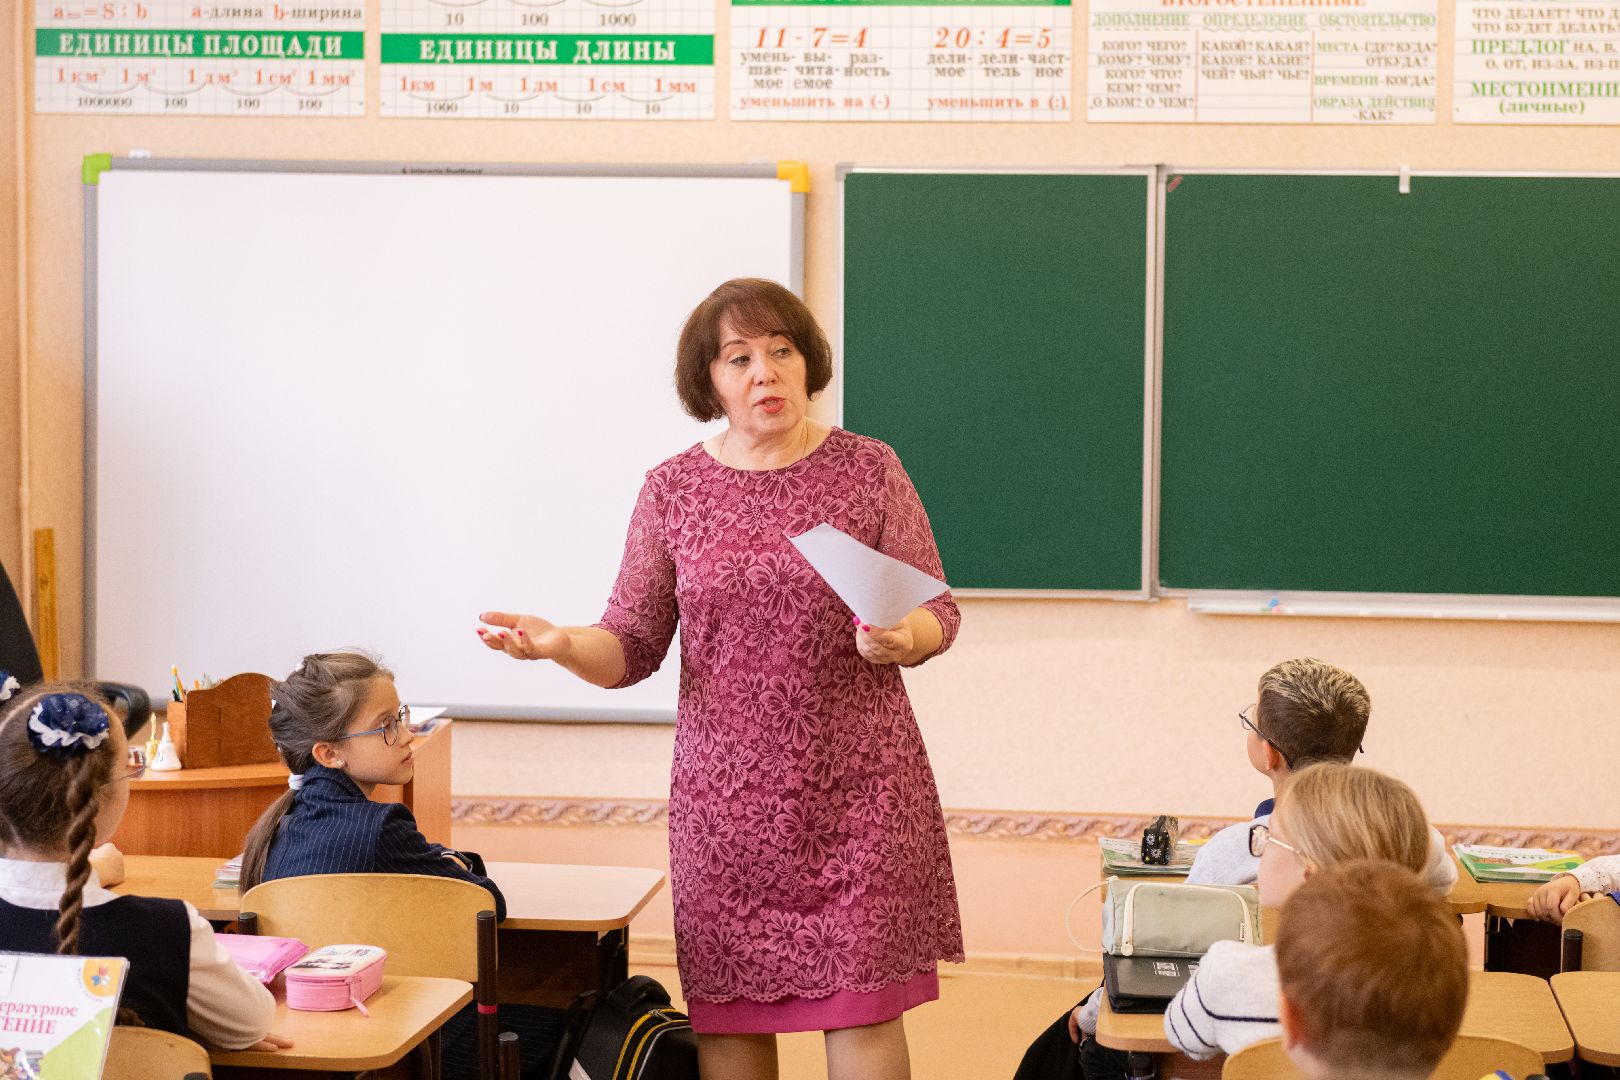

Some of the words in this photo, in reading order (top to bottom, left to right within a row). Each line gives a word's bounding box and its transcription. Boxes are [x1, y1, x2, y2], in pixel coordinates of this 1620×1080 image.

[446, 13, 464, 26] 10
[521, 13, 549, 26] 100
[600, 13, 637, 27] 1000
[1092, 13, 1190, 27] ДОПОЛНЕНИЕ
[1203, 13, 1306, 26] ОПРЕДЕЛЕНИЕ
[1319, 13, 1436, 27] ОБСТОЯТЕЛЬСТВО
[1472, 8, 1501, 19] ЧТО
[1576, 8, 1604, 19] ЧТО
[1472, 22, 1501, 33] ЧТО
[1505, 22, 1552, 34] БУДЕТ
[59, 32, 195, 56] ЕДИНИЦЫ
[203, 34, 343, 58] ПЛОЩАДИ
[419, 39, 559, 63] ЕДИНИЦЫ
[572, 40, 677, 64] ДЛИНЫ
[1472, 39, 1570, 55] ПРЕДЛОГ
[844, 66, 890, 77] ность
[935, 67, 966, 78] мое
[984, 67, 1021, 78] тель
[1035, 67, 1065, 78] ное
[753, 78, 783, 89] мое
[165, 97, 188, 107] 100
[237, 98, 260, 109] 100
[299, 99, 322, 109] 100
[426, 102, 458, 113] 1000
[504, 102, 519, 113] 10
[576, 103, 592, 114] 10
[645, 103, 661, 114] 10
[740, 96, 835, 109] уменьшить
[843, 96, 863, 107] на
[927, 96, 1023, 110] уменьшить
[1030, 97, 1039, 108] в
[1499, 100, 1585, 115] (личные)
